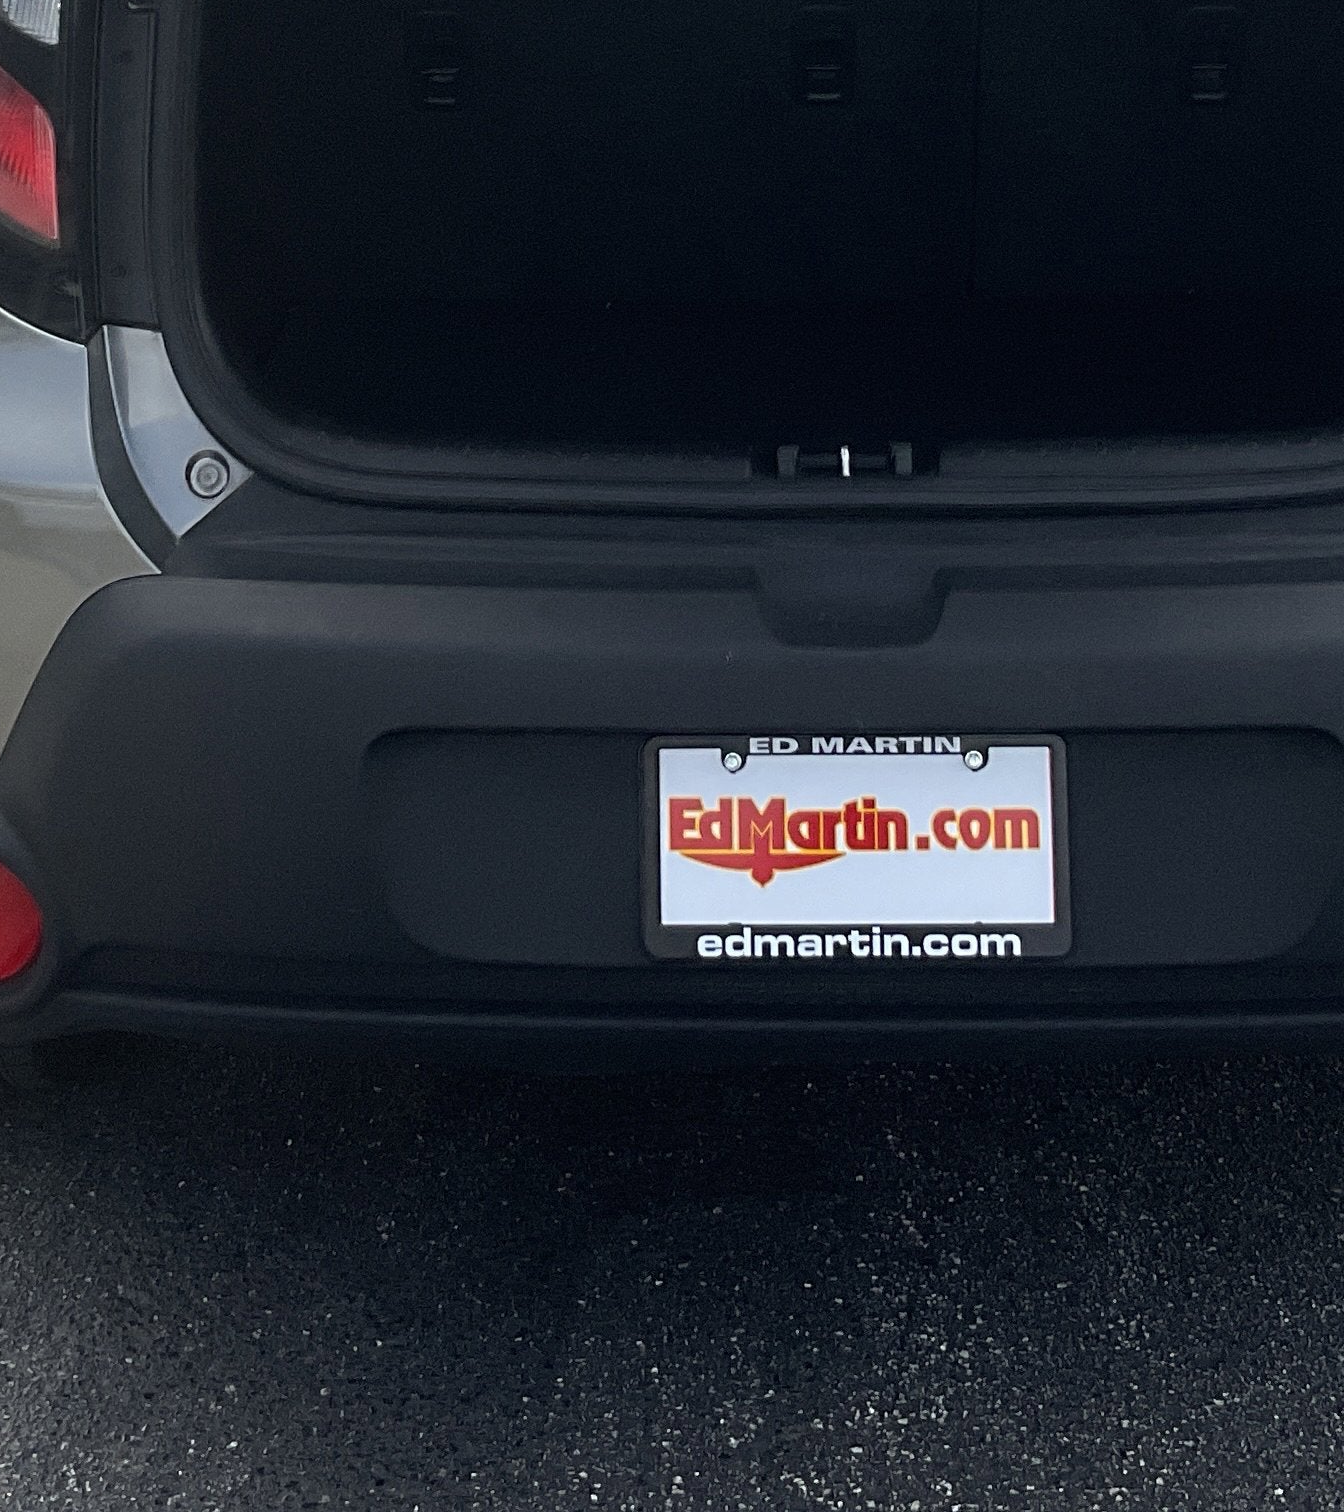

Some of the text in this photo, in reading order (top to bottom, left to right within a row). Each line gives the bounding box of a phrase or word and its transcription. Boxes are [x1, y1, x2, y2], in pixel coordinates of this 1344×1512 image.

[749, 736, 962, 754] ED MARTIN
[667, 794, 1041, 852] EdMartin.com
[696, 926, 1022, 958] edmartin.com
